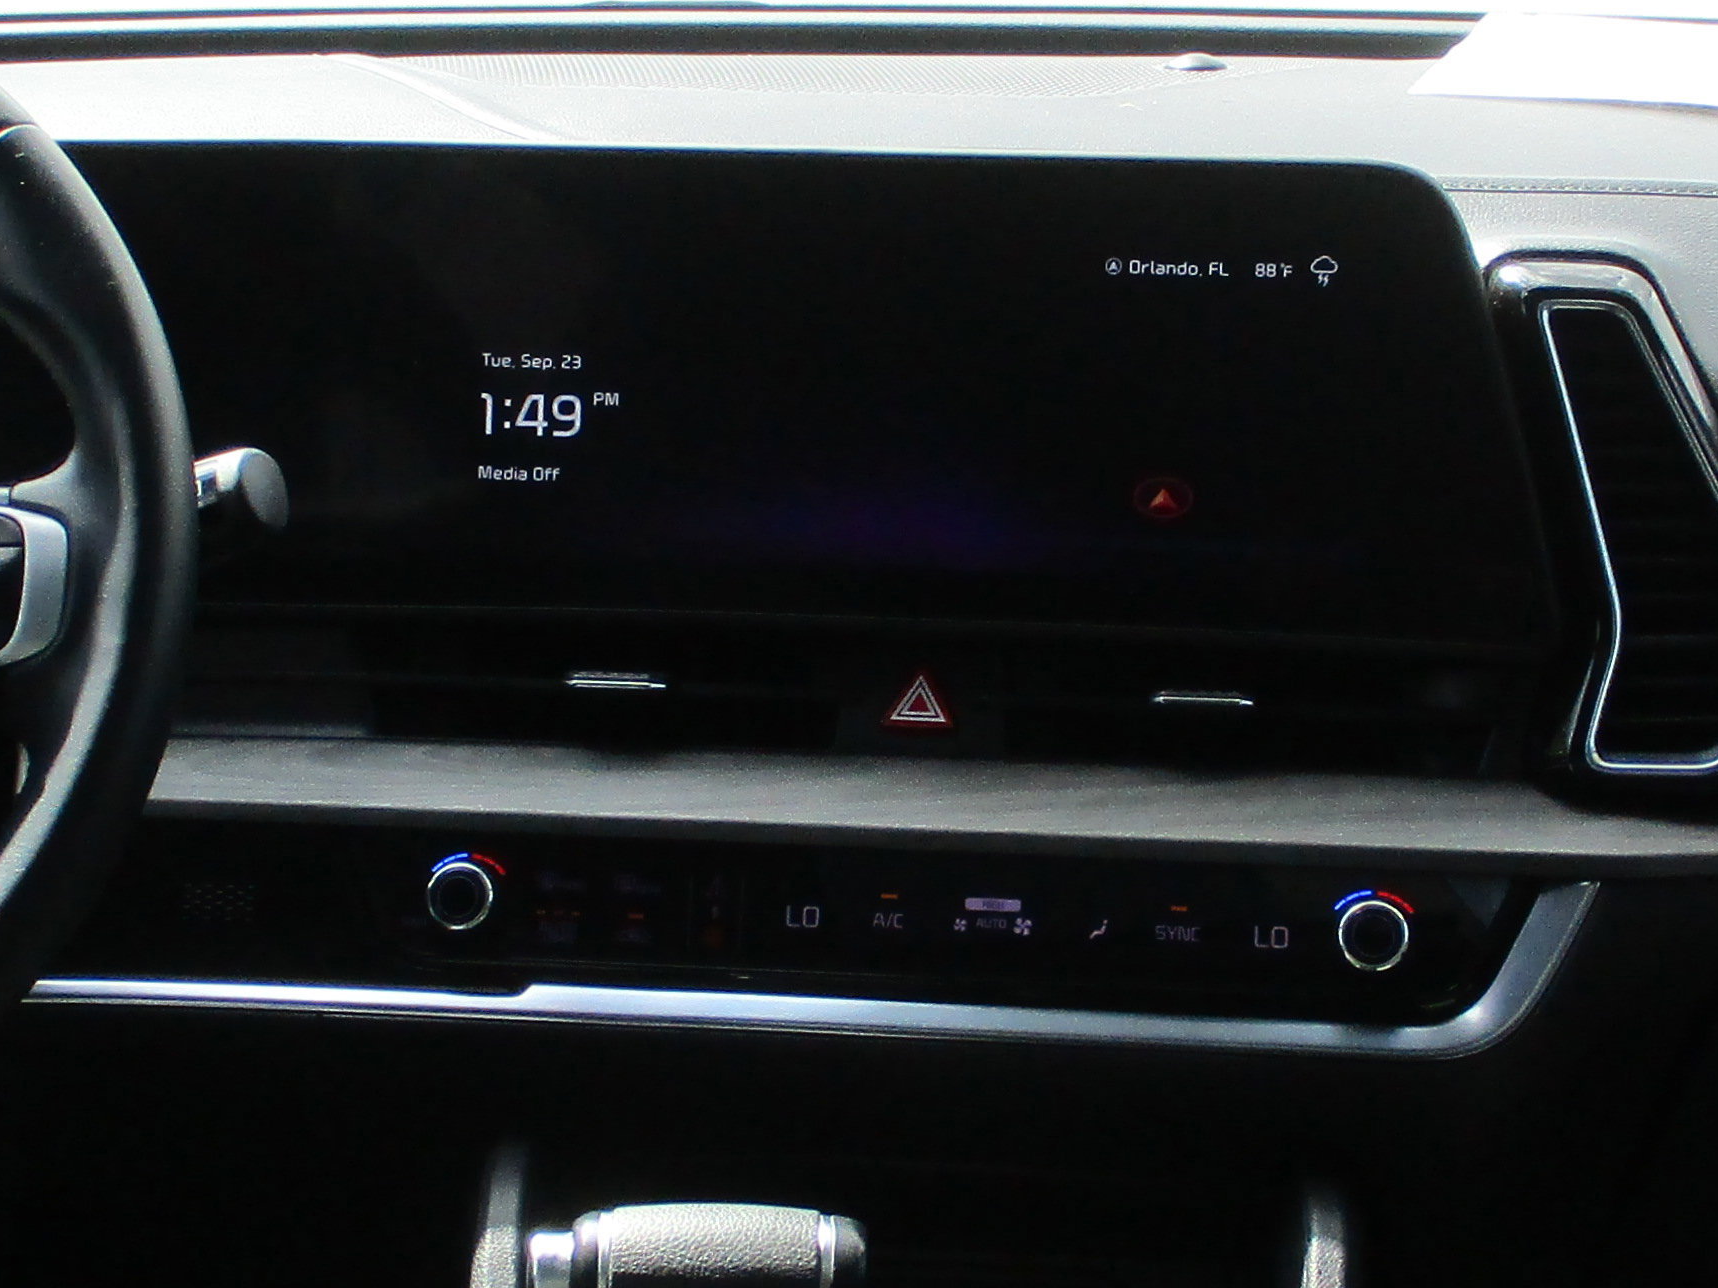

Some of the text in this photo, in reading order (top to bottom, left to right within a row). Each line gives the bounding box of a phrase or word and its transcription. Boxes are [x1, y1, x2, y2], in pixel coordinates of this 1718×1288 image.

[1208, 261, 1229, 277] FL
[520, 353, 556, 371] Sep.
[560, 354, 582, 370] 23
[480, 392, 620, 438] 1:49 PM
[477, 465, 561, 482] Media Off
[785, 904, 820, 929] LO
[872, 911, 905, 930] A/C
[975, 917, 1008, 930] AUTO
[1154, 924, 1202, 943] SYNC
[1253, 924, 1290, 950] LO
